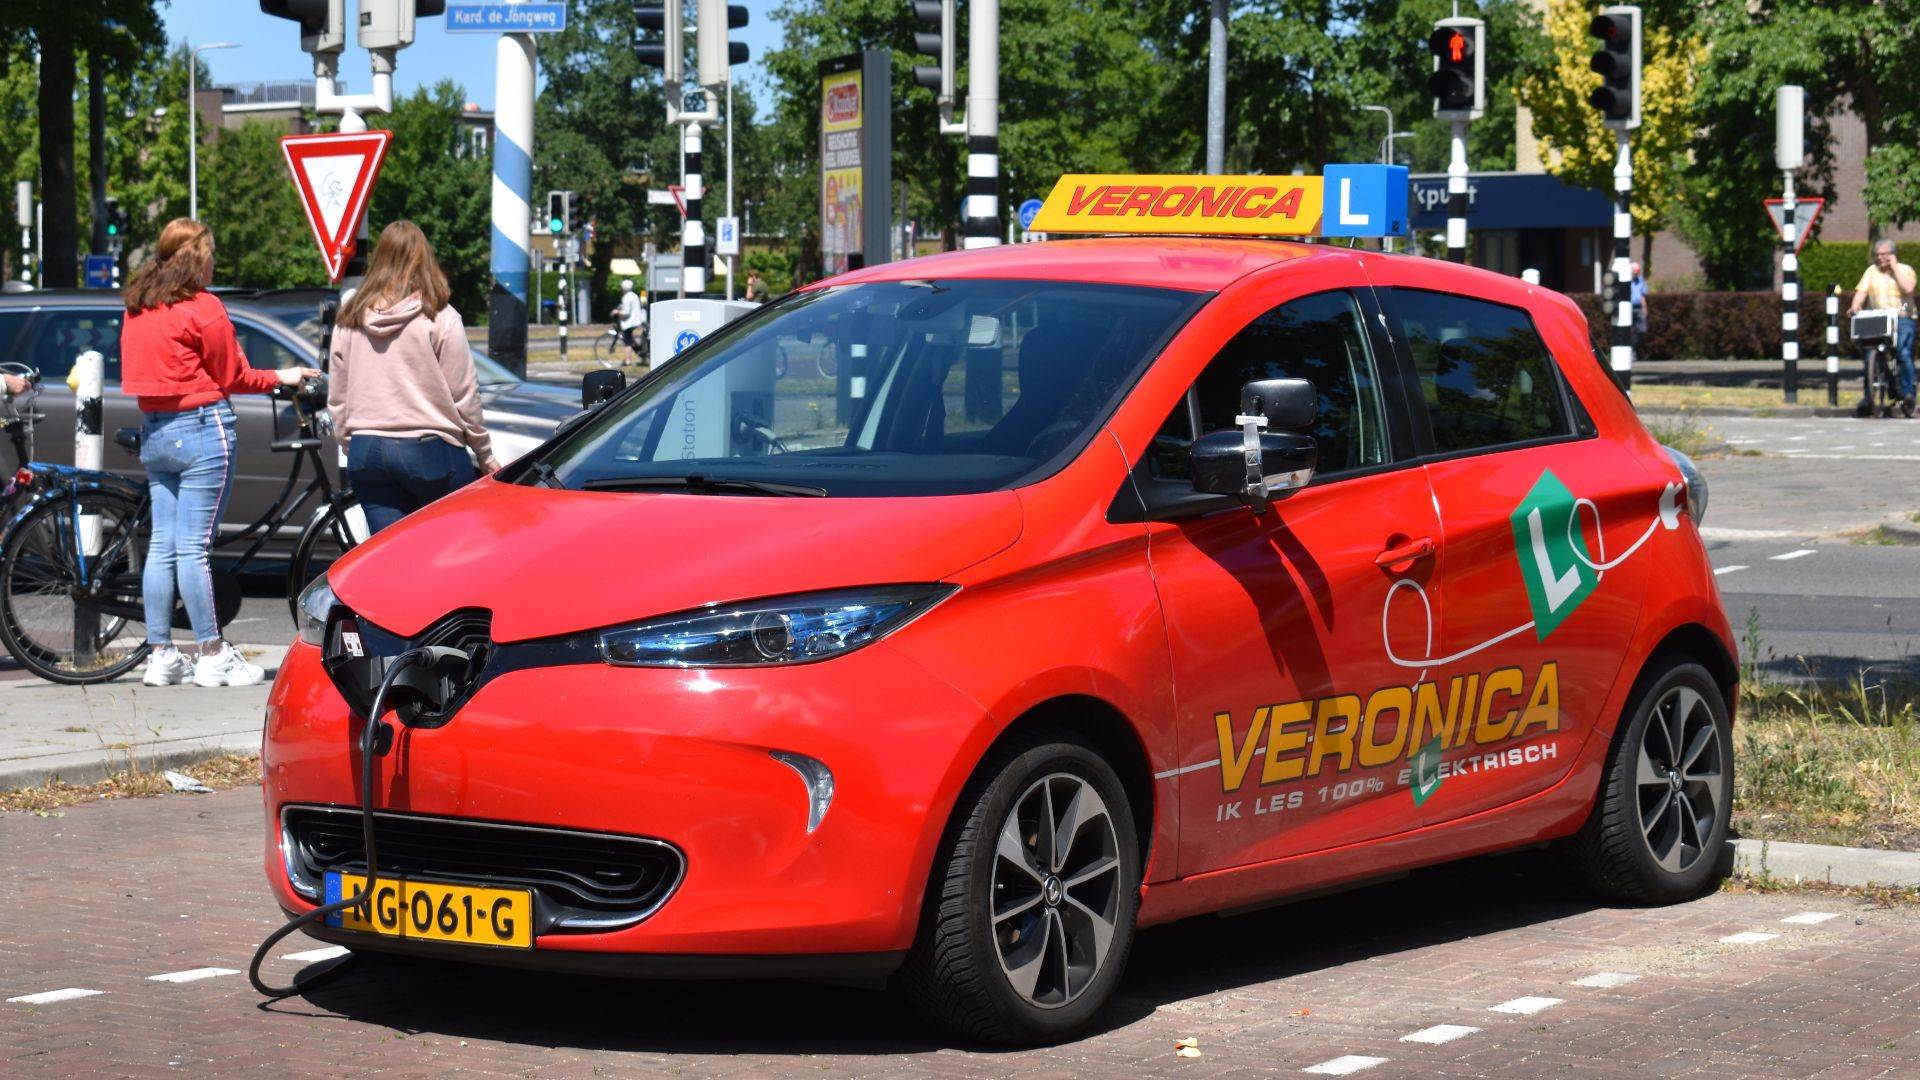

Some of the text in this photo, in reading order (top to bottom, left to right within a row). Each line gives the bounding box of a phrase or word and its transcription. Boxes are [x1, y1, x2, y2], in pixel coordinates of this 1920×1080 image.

[455, 9, 556, 27] Kard. de Jongweg
[1067, 185, 1304, 219] VERONICA
[1339, 178, 1369, 225] L
[1528, 506, 1582, 614] L
[1213, 660, 1561, 794] VERONICA
[1216, 742, 1557, 822] IK LES 100% ELEKTRISCH
[352, 882, 515, 941] NG-061-G
